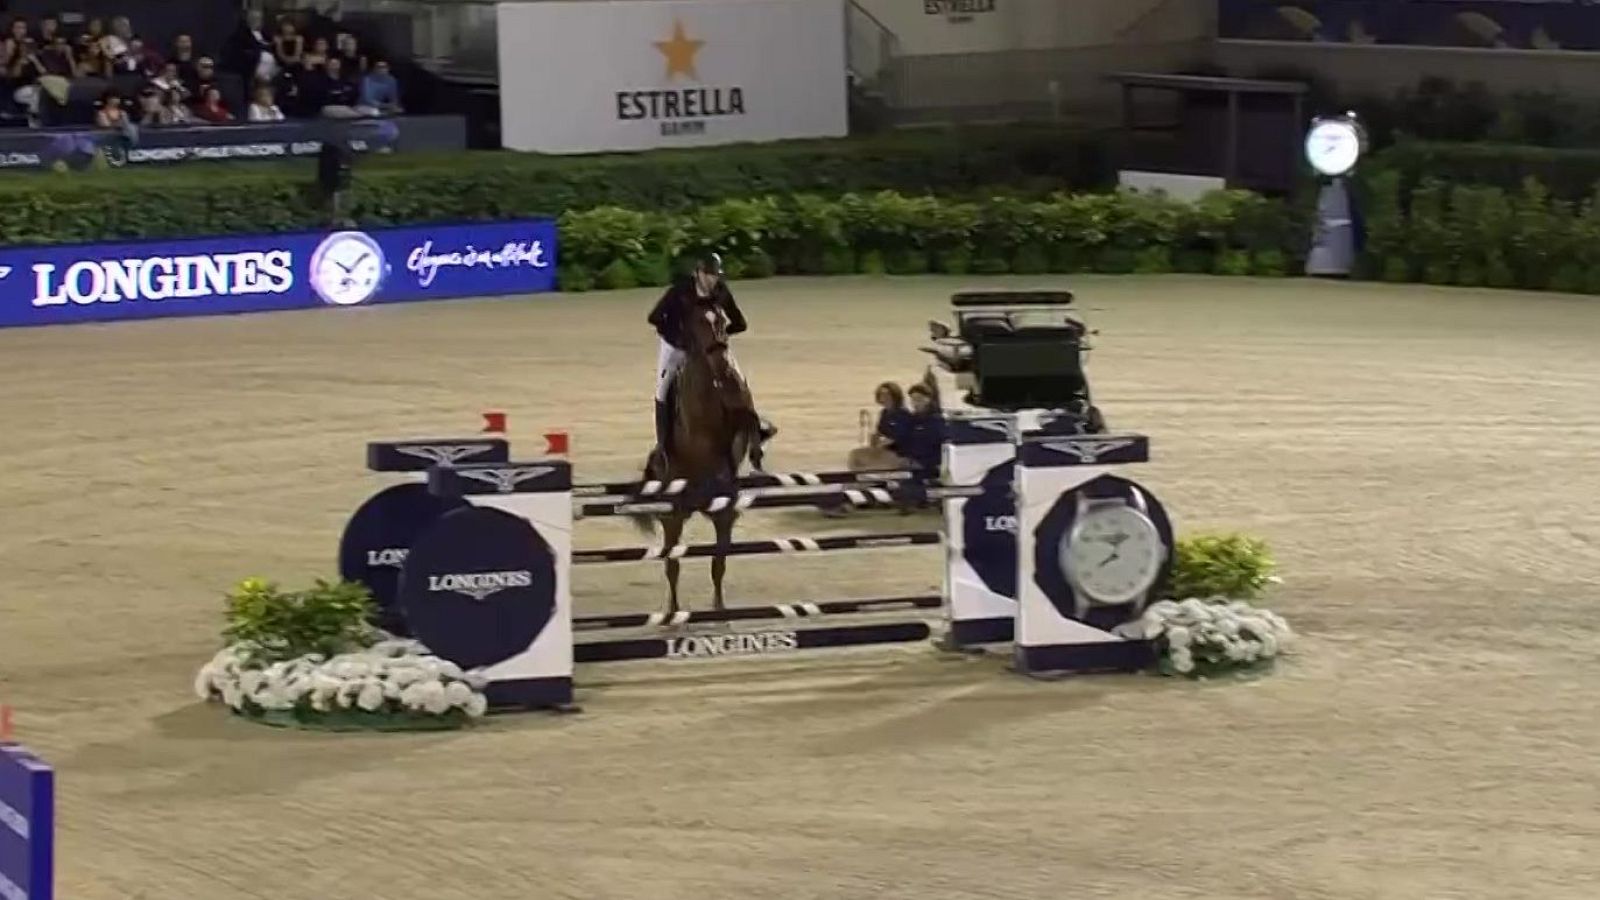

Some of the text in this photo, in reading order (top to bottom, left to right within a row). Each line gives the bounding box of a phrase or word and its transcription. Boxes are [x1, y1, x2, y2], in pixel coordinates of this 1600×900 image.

[617, 87, 745, 119] ESTRELLA
[32, 250, 293, 306] LONGINES
[429, 569, 533, 592] LONGINES
[666, 631, 798, 658] LONGINES
